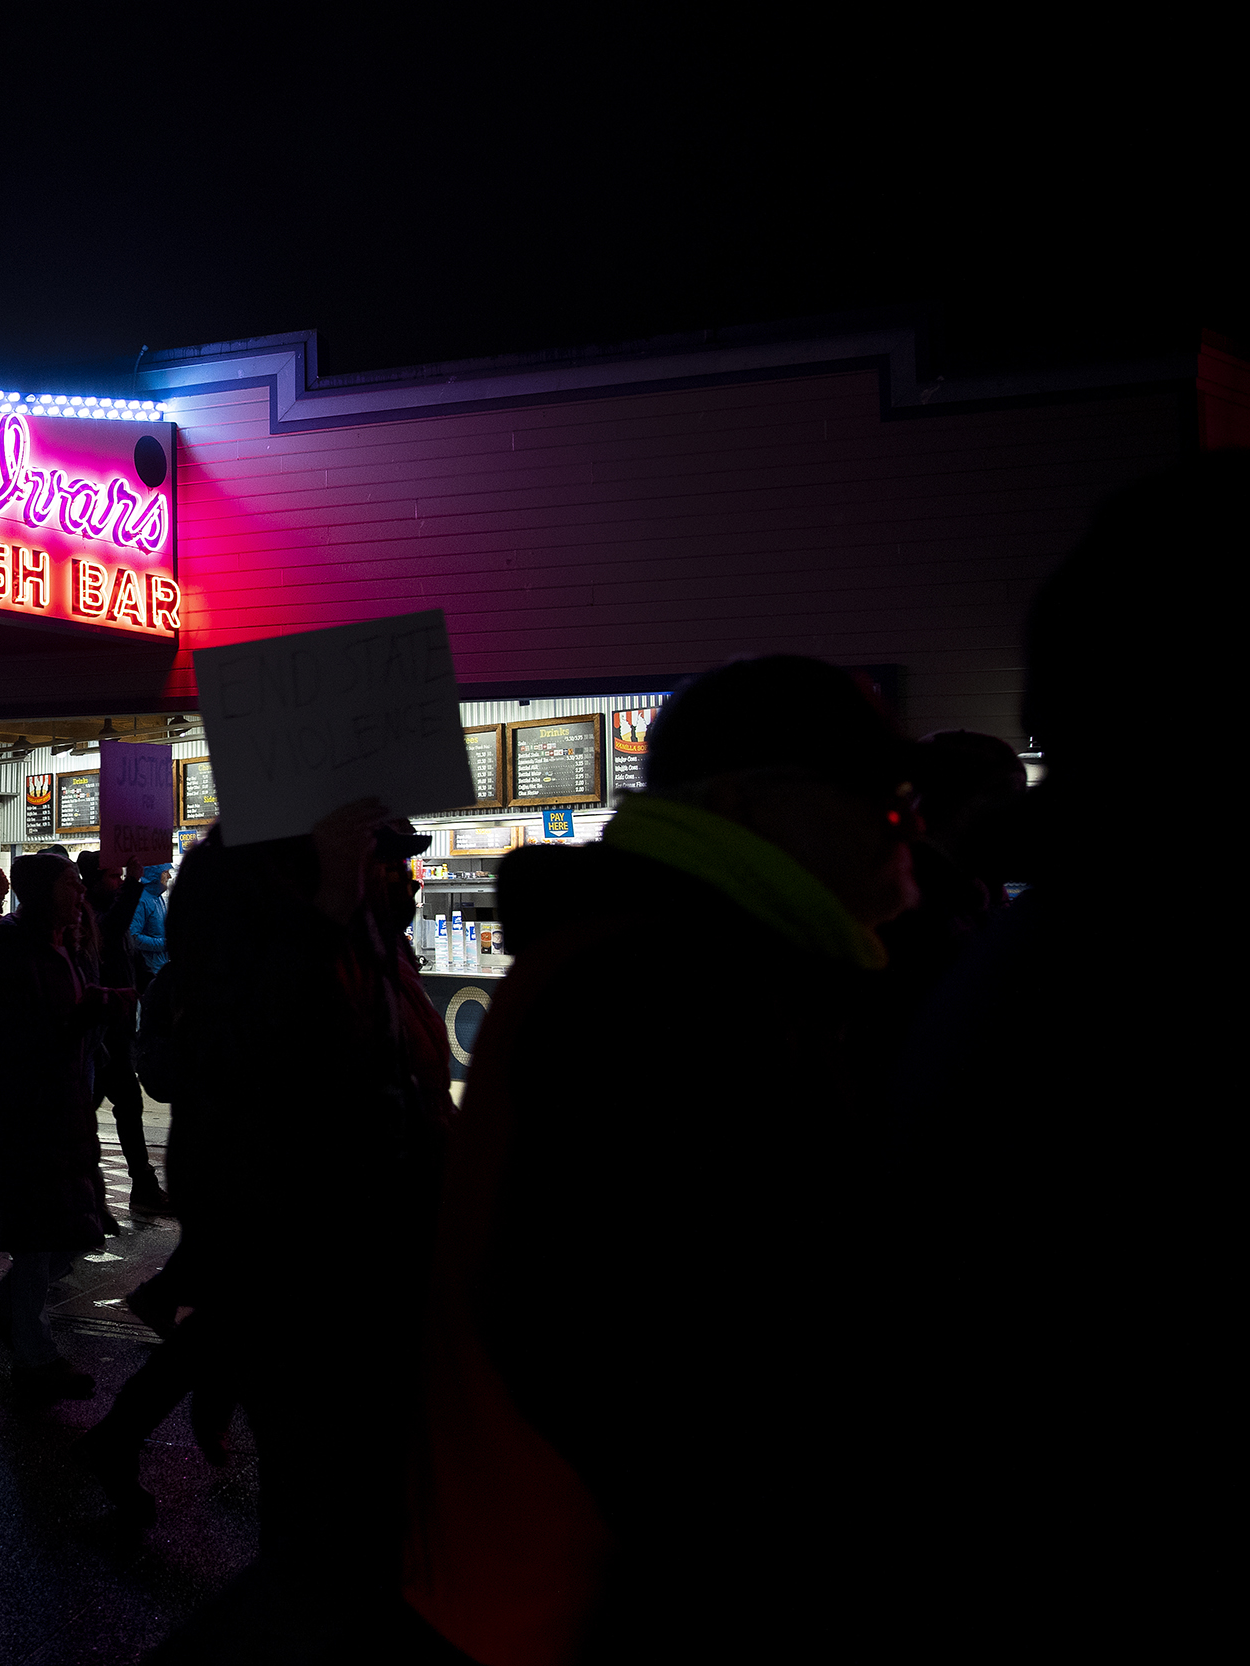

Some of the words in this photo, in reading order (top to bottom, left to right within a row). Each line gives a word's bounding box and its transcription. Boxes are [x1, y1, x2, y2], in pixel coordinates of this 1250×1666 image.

[71, 558, 181, 630] BAR
[218, 650, 320, 720] END
[343, 624, 452, 693] STATE
[250, 698, 446, 782] VIOLENCE
[540, 728, 570, 738] Drinks
[616, 741, 637, 751] VANILLA
[117, 756, 172, 788] JUSTICE
[548, 821, 569, 831] HERE
[550, 813, 565, 821] PAY
[114, 825, 149, 852] RENEE
